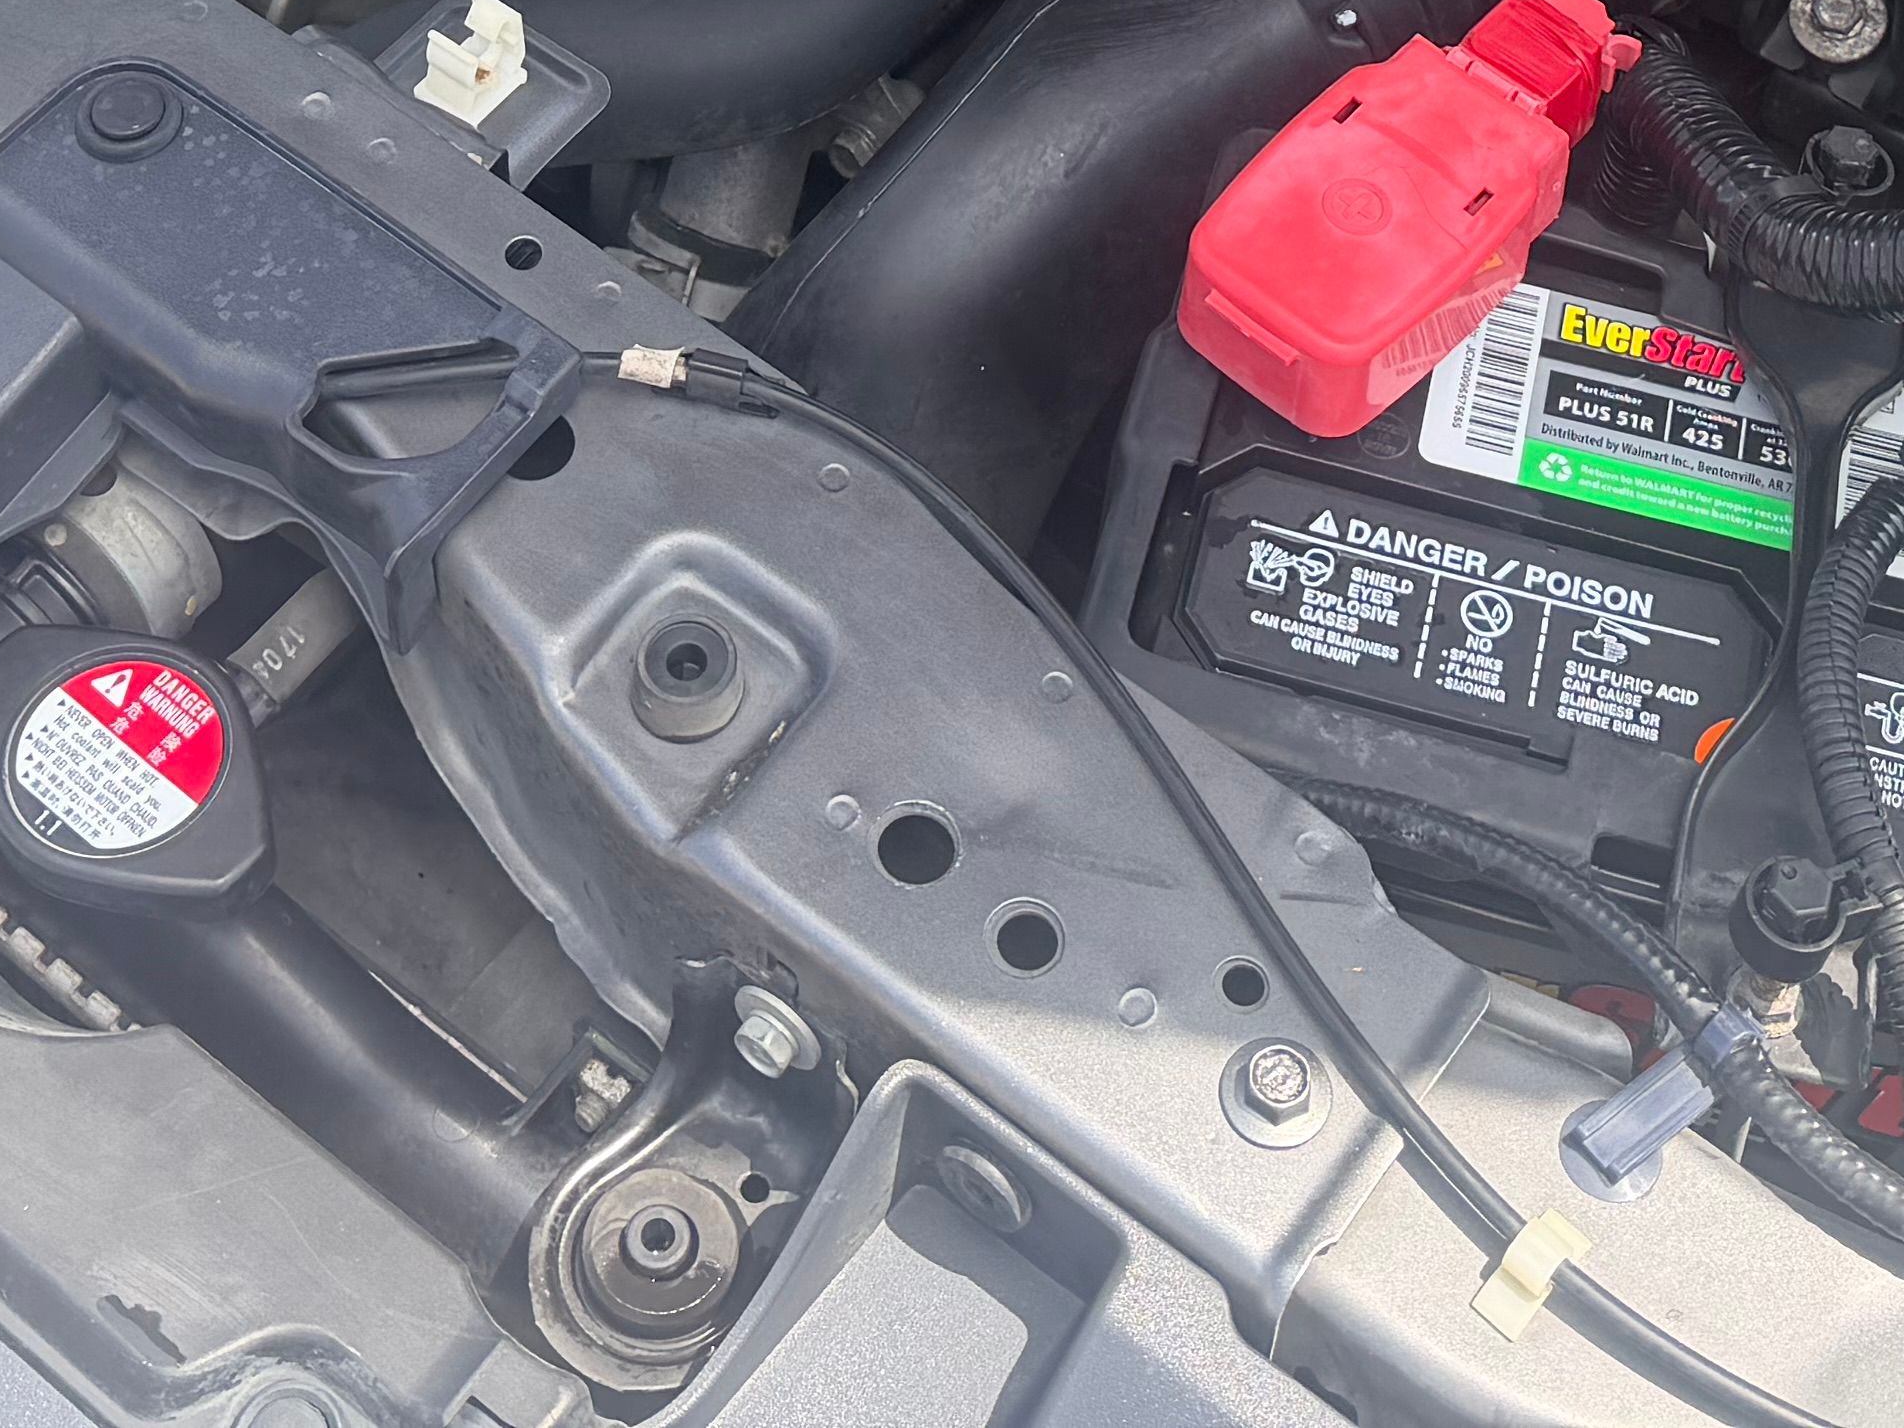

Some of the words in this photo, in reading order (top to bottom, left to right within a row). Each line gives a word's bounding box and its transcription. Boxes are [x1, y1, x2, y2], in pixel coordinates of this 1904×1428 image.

[1683, 375, 1731, 398] PLUS
[1557, 395, 1612, 423] PLUS
[1615, 409, 1656, 434] 51R
[1540, 421, 1606, 449] Distributed
[1604, 437, 1620, 454] by
[1619, 441, 1669, 465] Walmart
[1695, 461, 1766, 490] Bentonville,
[1766, 479, 1785, 492] AR
[1680, 425, 1725, 451] 425
[1578, 477, 1599, 490] and
[1600, 482, 1634, 498] credit
[1686, 502, 1709, 516] new
[1711, 506, 1754, 528] battery
[1580, 464, 1619, 482] Return
[1620, 474, 1633, 486] to
[1634, 477, 1695, 500] WALMART
[1696, 490, 1712, 502] for
[1714, 494, 1753, 514] proper
[1346, 518, 1488, 577] DANGER
[1521, 563, 1656, 620] POISON
[1348, 565, 1415, 596] SHIELD
[1300, 587, 1401, 627] EXPLOSIVE
[1345, 581, 1396, 608] EYES
[1248, 609, 1280, 629] CAN
[1278, 617, 1327, 642] CAUSE
[1324, 629, 1402, 662] BLINDNESS
[1296, 603, 1361, 633] GASES
[1288, 635, 1313, 653] OR
[1310, 641, 1360, 667] INJURY
[1449, 648, 1504, 672] SPARKS
[1463, 632, 1494, 654] NO
[1444, 677, 1506, 704] SMOKING
[1446, 664, 1500, 686] FLAMES
[1560, 675, 1592, 695] CAN
[1594, 684, 1643, 709] CAUSE
[1562, 658, 1655, 697] SULFURIC
[1654, 682, 1701, 708] ACID
[139, 683, 200, 740] WARNUNG
[153, 669, 217, 723] DANGER
[1559, 690, 1634, 718] BLINDNESS
[1639, 710, 1661, 728] OR
[64, 704, 90, 730] NEVER
[91, 726, 113, 749] OPEN
[115, 748, 138, 772] WHEN
[1556, 705, 1610, 731] SEVERE
[1612, 718, 1660, 742] BURNS
[31, 737, 52, 759] NICHT
[52, 754, 65, 770] BEI
[94, 791, 117, 814] MOTOR
[54, 714, 68, 731] Hot
[70, 730, 99, 758] coolant
[103, 756, 118, 773] will
[121, 773, 142, 795] scald
[144, 795, 160, 813] you.
[85, 763, 102, 782] PAS
[102, 779, 128, 805] QUAND
[33, 809, 63, 837] 1.1
